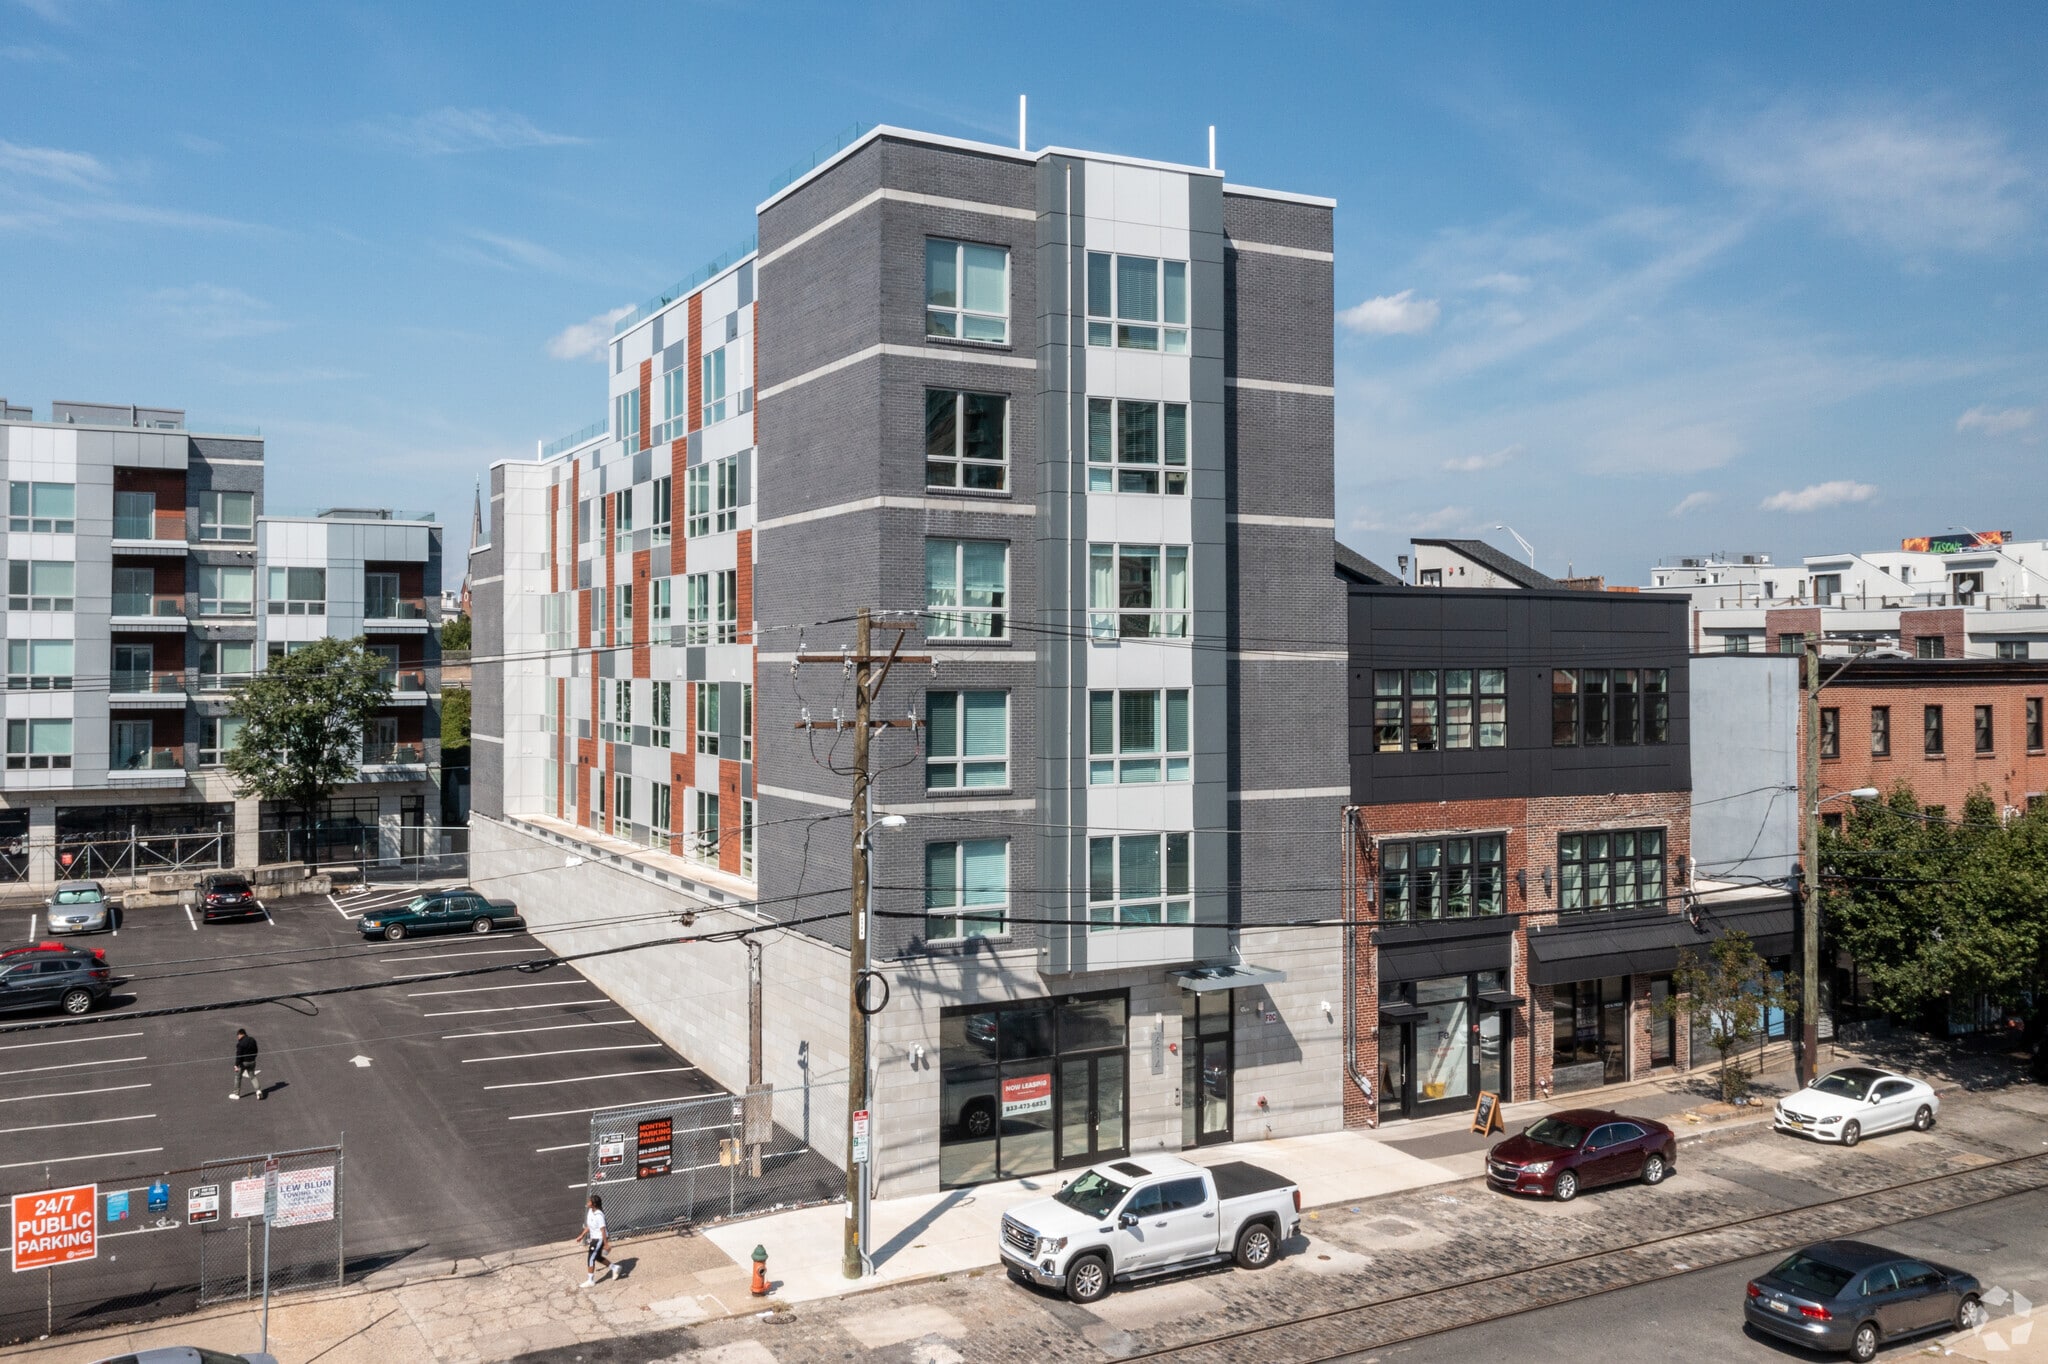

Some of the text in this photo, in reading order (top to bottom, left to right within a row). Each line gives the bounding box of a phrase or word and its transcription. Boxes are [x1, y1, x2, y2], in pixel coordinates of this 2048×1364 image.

[1005, 1080, 1048, 1092] NOW LEASING
[639, 1120, 671, 1131] MONTHLY
[639, 1127, 671, 1138] PARKING
[639, 1134, 671, 1145] AVAILABLE
[280, 1179, 332, 1193] LEW BLUM
[35, 1195, 75, 1216] 24/7
[18, 1211, 92, 1238] PUBLIC
[18, 1230, 93, 1255] PARKING
